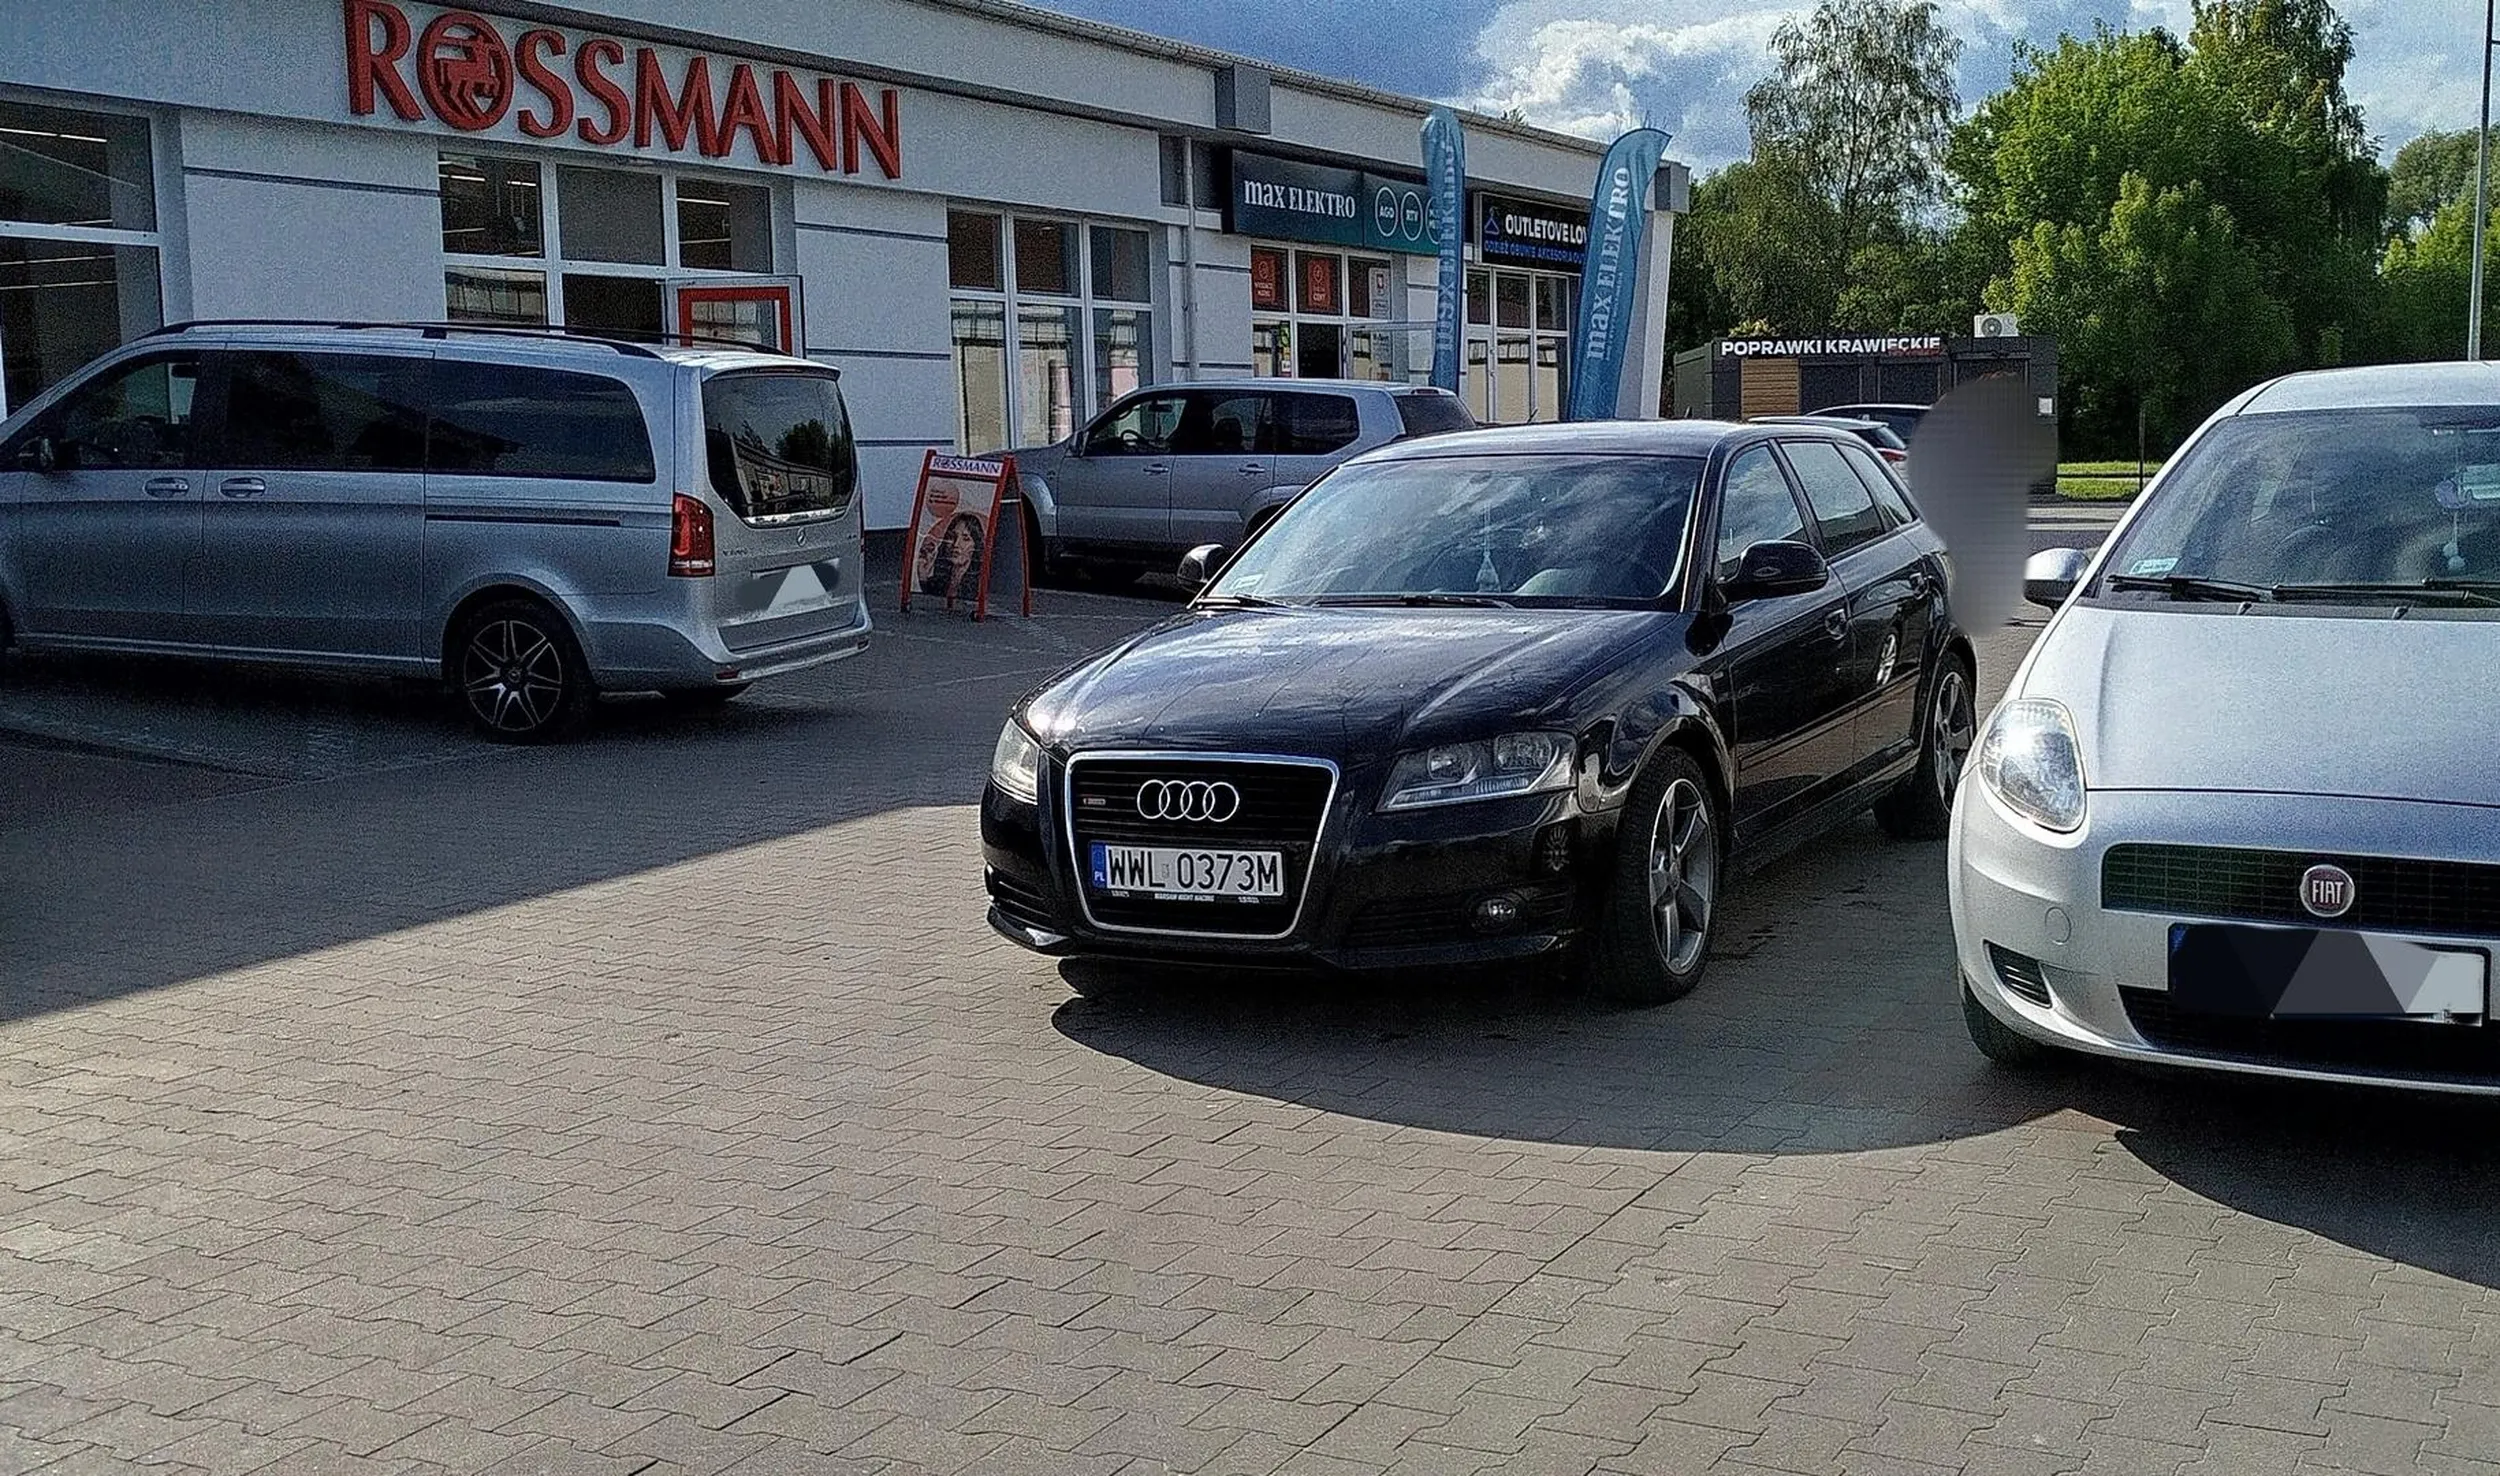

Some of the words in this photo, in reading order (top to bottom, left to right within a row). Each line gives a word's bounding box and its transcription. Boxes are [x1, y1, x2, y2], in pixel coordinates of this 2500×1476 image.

[345, 0, 900, 180] ROSSMANN
[1244, 180, 1286, 209] max
[1289, 186, 1356, 219] ELEKTRO
[1597, 167, 1630, 288] ELEKTRO
[1587, 293, 1613, 360] max
[1721, 340, 1822, 356] POPRAWKI
[1826, 337, 1941, 353] KRAWIECKIE
[933, 457, 1000, 474] ROSSMANN
[1094, 871, 1105, 881] PL
[1108, 849, 1166, 888] WWL
[1177, 852, 1278, 892] 0373M
[2312, 880, 2344, 904] FIAT
